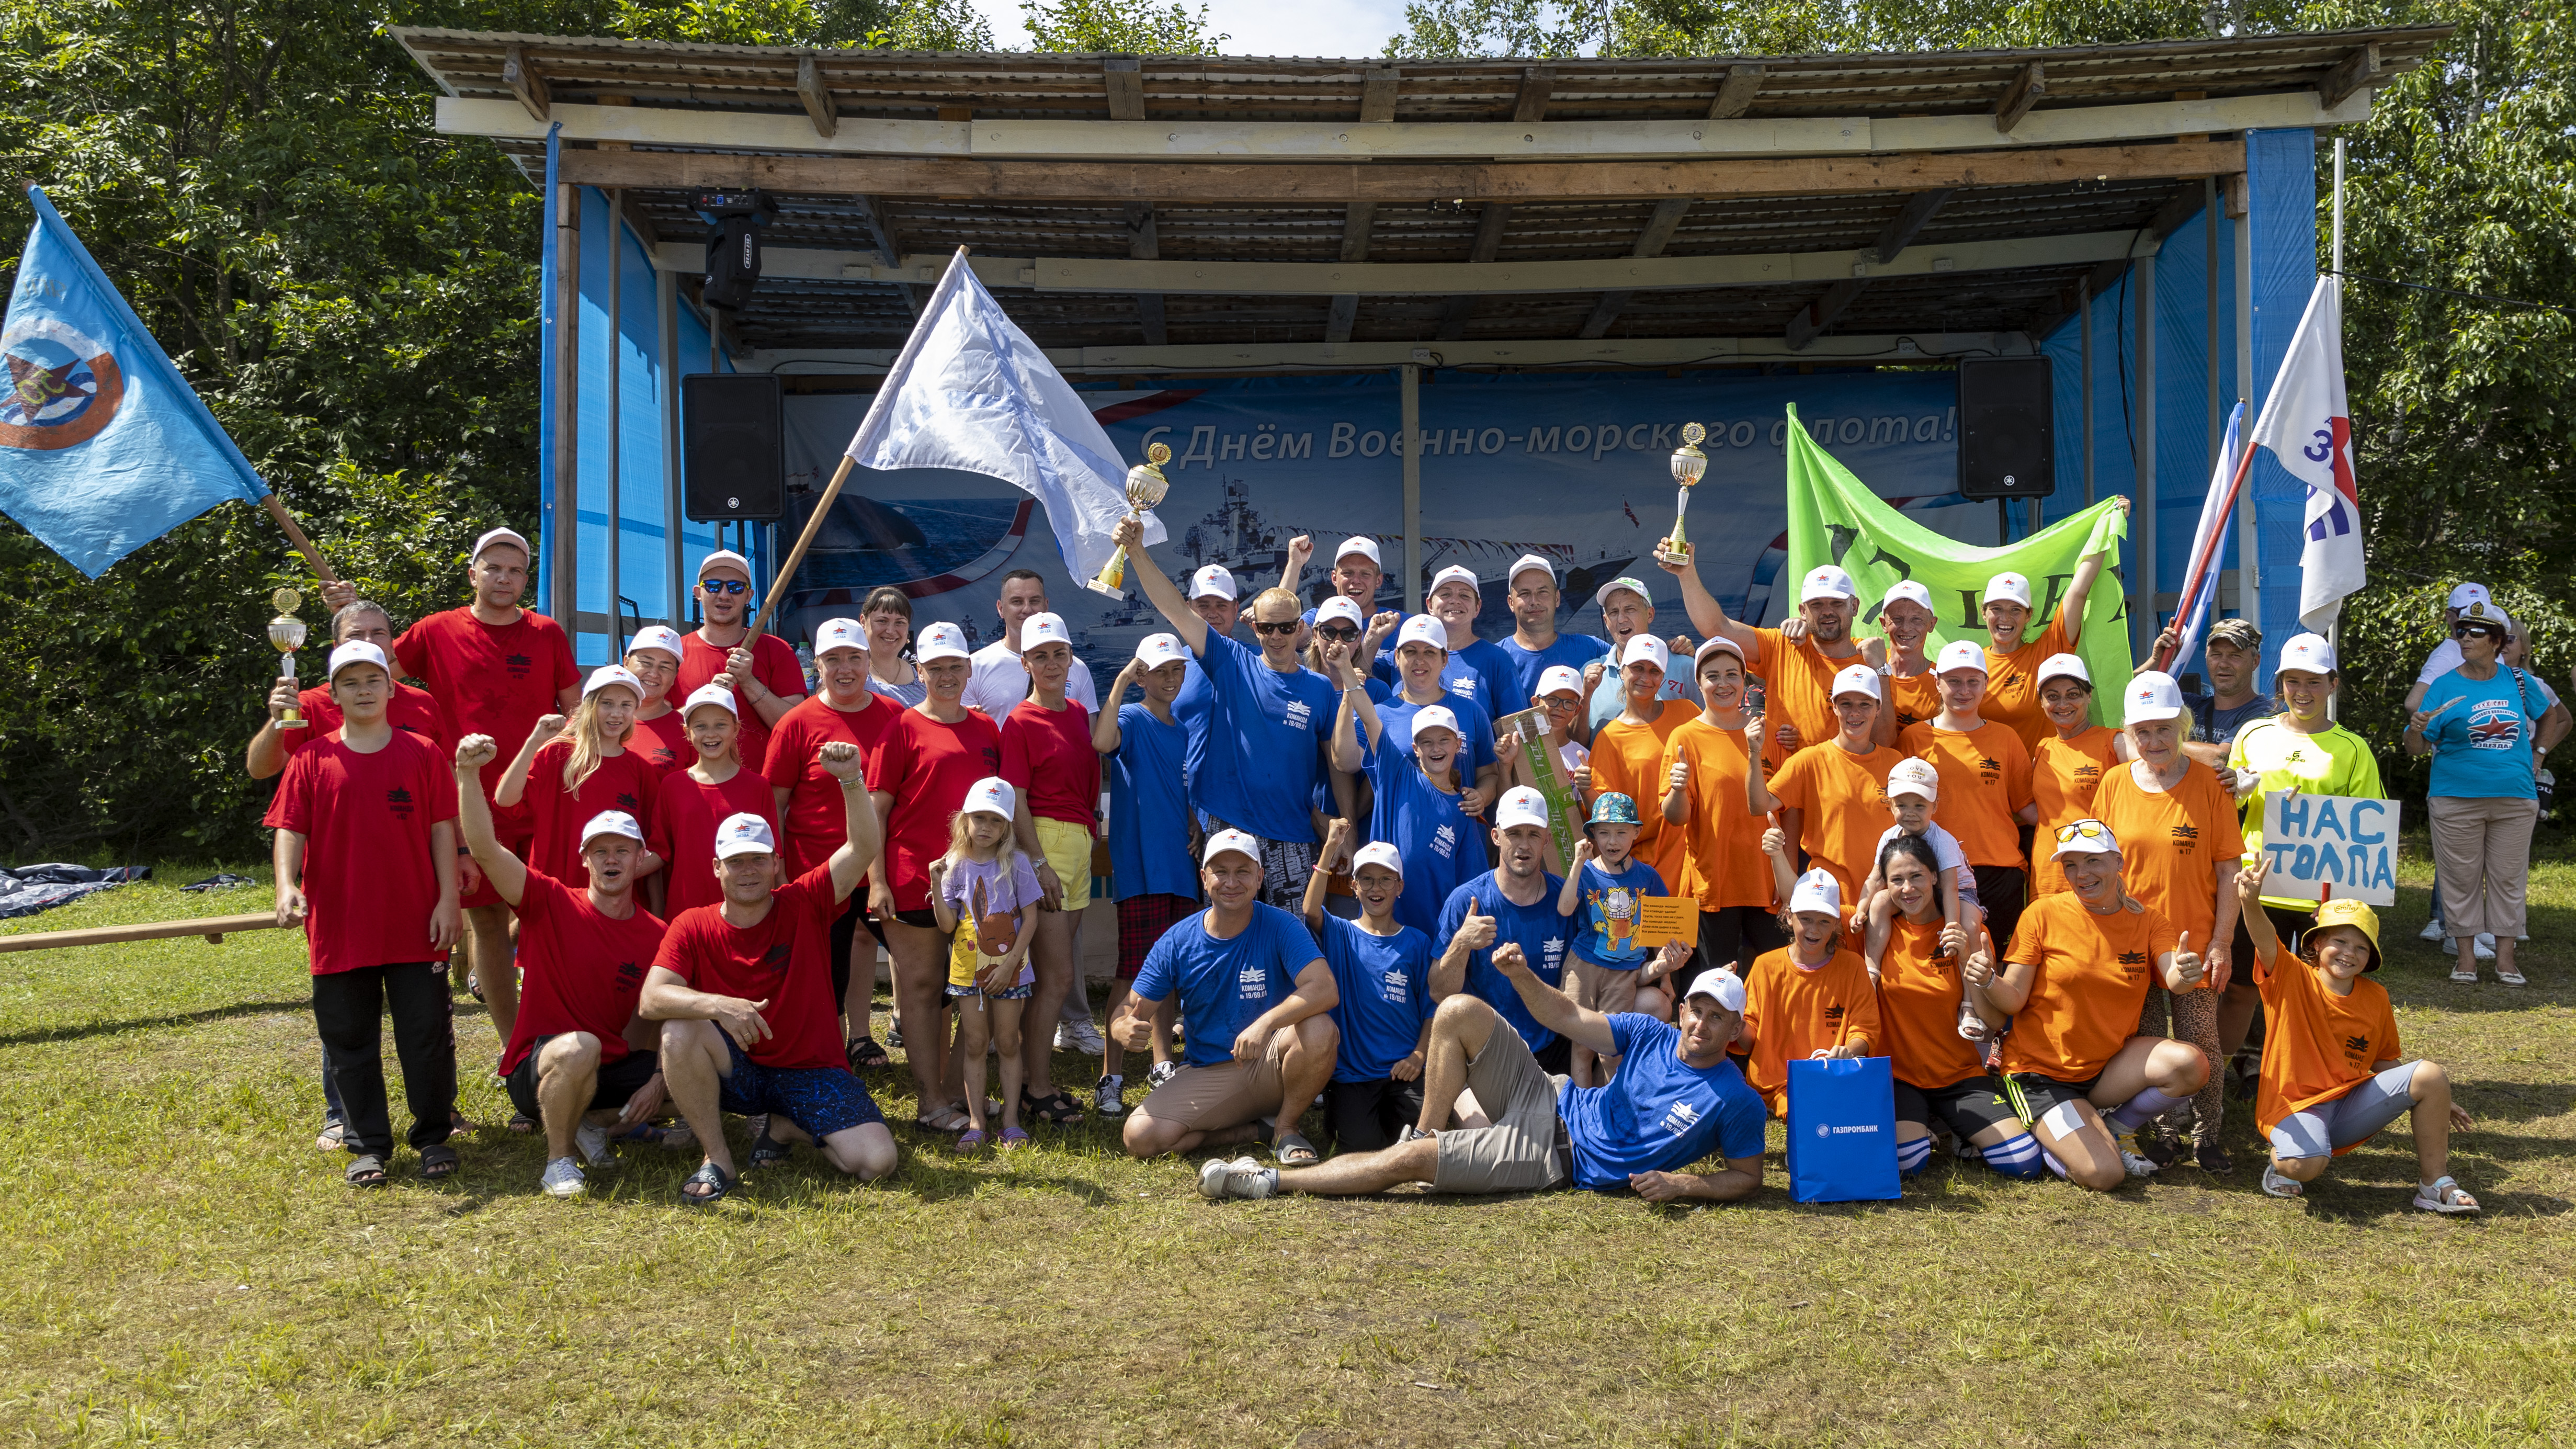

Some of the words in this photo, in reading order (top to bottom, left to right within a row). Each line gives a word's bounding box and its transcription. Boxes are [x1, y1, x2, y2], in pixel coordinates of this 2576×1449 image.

[1178, 424, 1312, 469] Днём
[1329, 418, 1765, 461] Военно-морскго
[2005, 685, 2025, 694] КОМАНДА
[1287, 712, 1308, 724] КОМАНДА
[1288, 720, 1307, 731] 19/69.01
[2280, 796, 2385, 845] НАС
[1434, 836, 1452, 852] КОМАНДА
[1434, 845, 1450, 859] 19/69.01
[2264, 842, 2396, 890] ТОЛПА
[1930, 959, 1953, 968] КОМАНДА
[1241, 983, 1266, 992] КОМАНДА
[1386, 985, 1405, 996] КОМАНДА
[1246, 991, 1267, 999] 19/69.01
[1832, 1125, 1878, 1134] ГАЗПРОМБАНК
